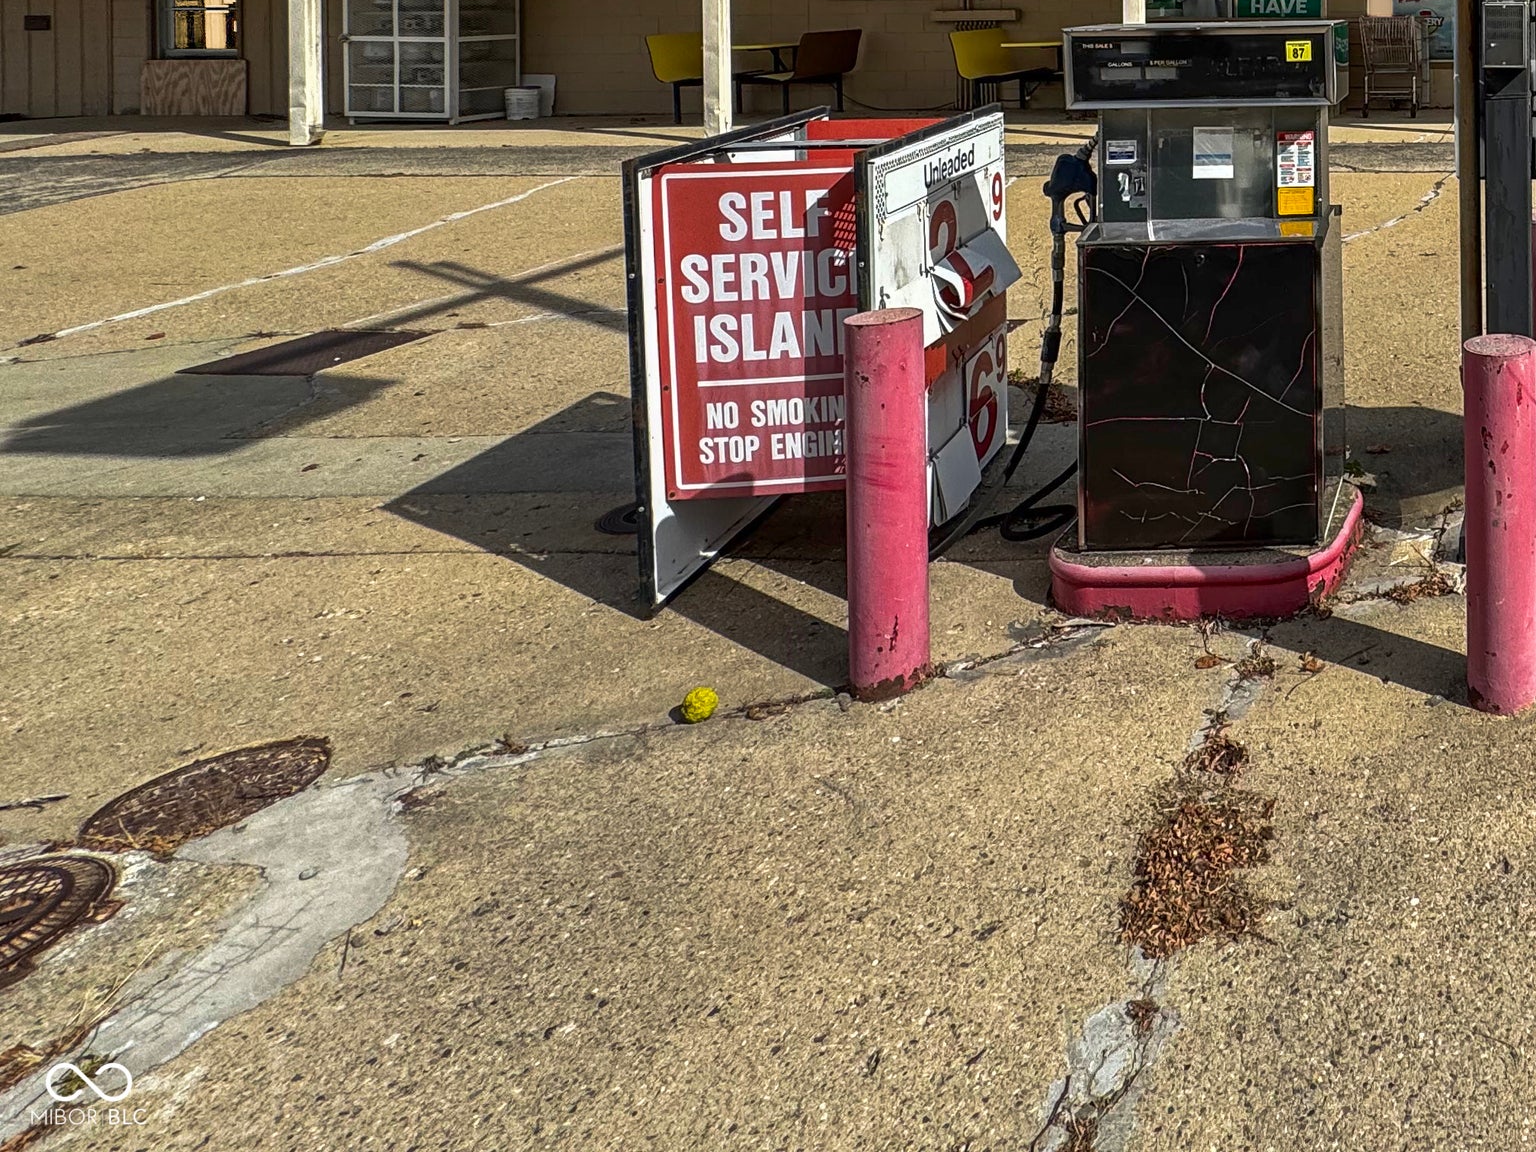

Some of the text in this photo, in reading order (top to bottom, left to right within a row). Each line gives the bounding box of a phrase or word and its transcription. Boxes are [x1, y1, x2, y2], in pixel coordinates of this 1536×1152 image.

[1292, 47, 1305, 59] 87
[924, 143, 975, 189] Unleaded
[718, 189, 829, 242] SELF
[992, 172, 1003, 222] 9
[706, 395, 846, 430] NO SMOKIN
[699, 429, 846, 465] STOP ENGIN
